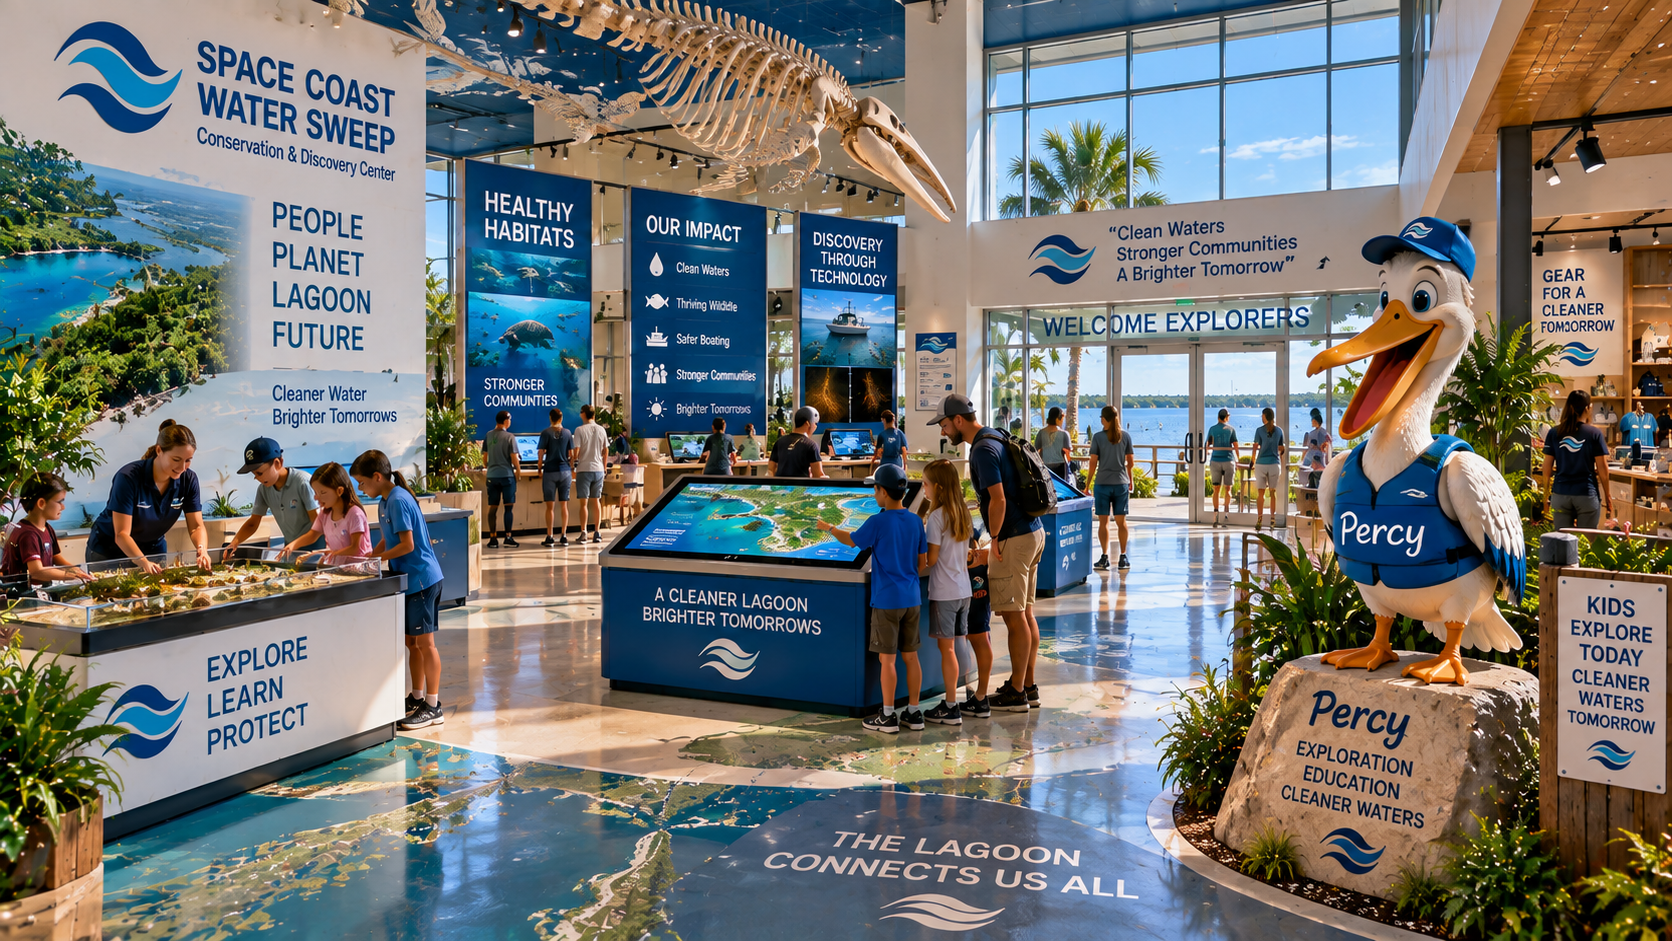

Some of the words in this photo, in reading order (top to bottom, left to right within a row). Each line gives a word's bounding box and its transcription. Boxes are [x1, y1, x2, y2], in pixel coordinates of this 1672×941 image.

[197, 40, 294, 94] SPACE
[305, 69, 396, 117] COAST
[197, 82, 297, 135] WATER
[306, 108, 395, 154] SWEEP
[197, 127, 284, 160] Conservation
[288, 146, 297, 162] &
[301, 149, 357, 177] Discovery
[359, 160, 396, 181] Center
[273, 201, 363, 241] PEOPLE
[484, 191, 574, 223] HEALTHY
[484, 218, 574, 249] HABITATS
[646, 214, 680, 237] OUR
[685, 220, 742, 243] IMPACT
[813, 231, 884, 253] DISCOVERY
[1167, 219, 1225, 238] Waters
[273, 241, 364, 277] PLANET
[820, 251, 876, 269] THROUGH
[1117, 242, 1185, 263] Stronger
[1188, 235, 1298, 258] Communities
[676, 262, 699, 274] Clean
[701, 264, 729, 277] Waters
[810, 268, 888, 288] TECHNOLOGY
[1117, 267, 1128, 282] A
[1133, 263, 1196, 284] Brighter
[1543, 268, 1585, 283] GEAR
[273, 281, 371, 314] LAGOON
[1543, 287, 1571, 300] FOR
[1576, 286, 1586, 299] A
[1043, 313, 1157, 337] WELCOME
[1166, 306, 1310, 333] EXPLORERS
[1542, 303, 1604, 316] CLEANER
[273, 321, 364, 351] FUTURE
[676, 333, 698, 345] Safer
[484, 377, 544, 390] STRONGER
[676, 369, 709, 382] Stronger
[273, 385, 325, 402] Cleaner
[329, 386, 367, 402] Water
[273, 409, 326, 428] Brighter
[329, 408, 397, 424] Tomorrows
[676, 404, 708, 416] Brighter
[1339, 511, 1425, 557] Percy
[655, 588, 666, 600] A
[669, 588, 738, 608] CLEANER
[742, 594, 808, 613] LAGOON
[1587, 595, 1635, 618] KIDS
[642, 606, 716, 627] BRIGHTER
[720, 612, 822, 635] TOMORROWS
[1571, 620, 1653, 644] EXPLORE
[207, 635, 308, 683] EXPLORE
[1579, 644, 1644, 667] TODAY
[1572, 669, 1650, 693] CLEANER
[207, 675, 284, 719] LEARN
[1579, 690, 1644, 713] WATERS
[207, 702, 308, 755] PROTECT
[1308, 690, 1410, 750] Percy
[1567, 710, 1655, 735] TOMORROW
[1296, 740, 1414, 778] EXPLORATION
[1303, 765, 1400, 800] EDUCATION
[1281, 784, 1352, 814] CLEANER
[1356, 802, 1425, 829] WATERS
[832, 831, 905, 854] THE
[913, 838, 1081, 867] LAGOON
[763, 851, 981, 885] CONNECTS
[995, 869, 1048, 891] US
[1060, 876, 1140, 899] ALL
